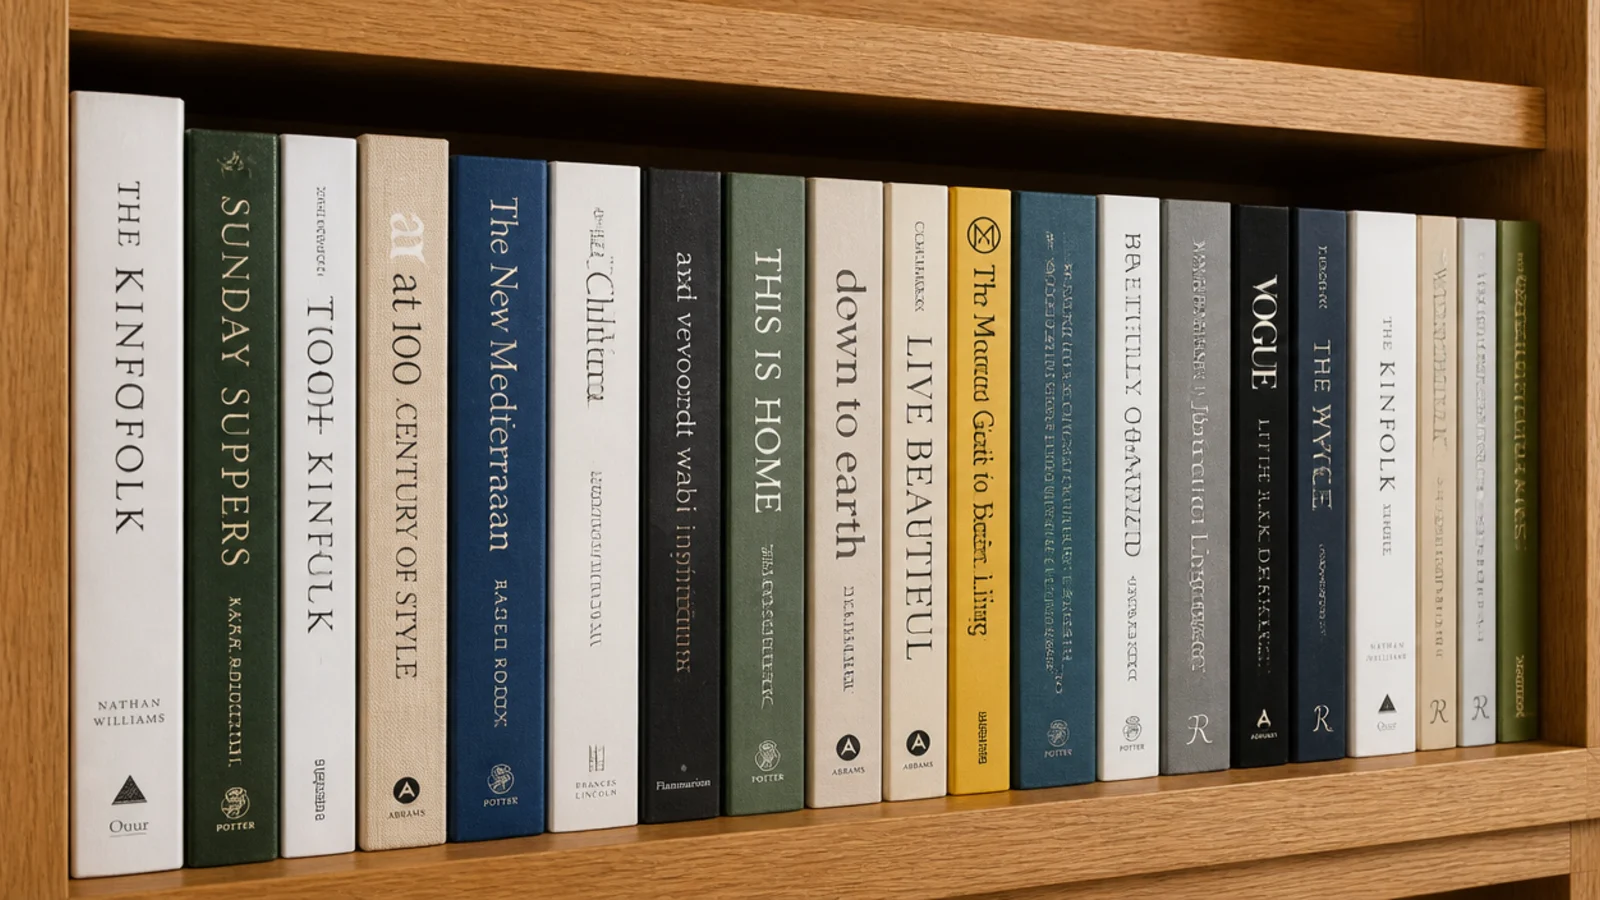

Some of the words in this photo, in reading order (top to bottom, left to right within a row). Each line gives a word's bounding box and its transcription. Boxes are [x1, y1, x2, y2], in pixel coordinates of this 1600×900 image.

[118, 181, 140, 246] THE
[491, 197, 518, 254] The
[221, 196, 249, 366] SUNDAY
[392, 274, 421, 312] at
[491, 264, 518, 332] New
[755, 248, 781, 333] THIS
[392, 323, 421, 385] 100
[836, 270, 866, 387] down
[1252, 275, 1277, 389] VOGUE
[1383, 317, 1392, 350] THE
[755, 350, 781, 380] IS
[907, 336, 932, 423] LIVE
[1314, 340, 1330, 392] THE
[115, 267, 144, 534] KINFOFOLK
[836, 399, 860, 437] to
[1380, 362, 1395, 491] KINFOLK
[221, 388, 250, 566] SUPPERS
[677, 448, 697, 511] wabi
[755, 398, 781, 513] HOME
[836, 452, 865, 559] earth
[396, 547, 417, 581] OF
[396, 592, 417, 679] STYLE
[93, 712, 165, 727] WILLIAMS
[97, 698, 162, 711] NATHAN
[831, 766, 866, 776] ABRAMS
[1120, 743, 1145, 752] POTTER
[483, 796, 519, 807] POTTER
[575, 788, 617, 799] LINCOLN
[216, 821, 255, 832] POTTER
